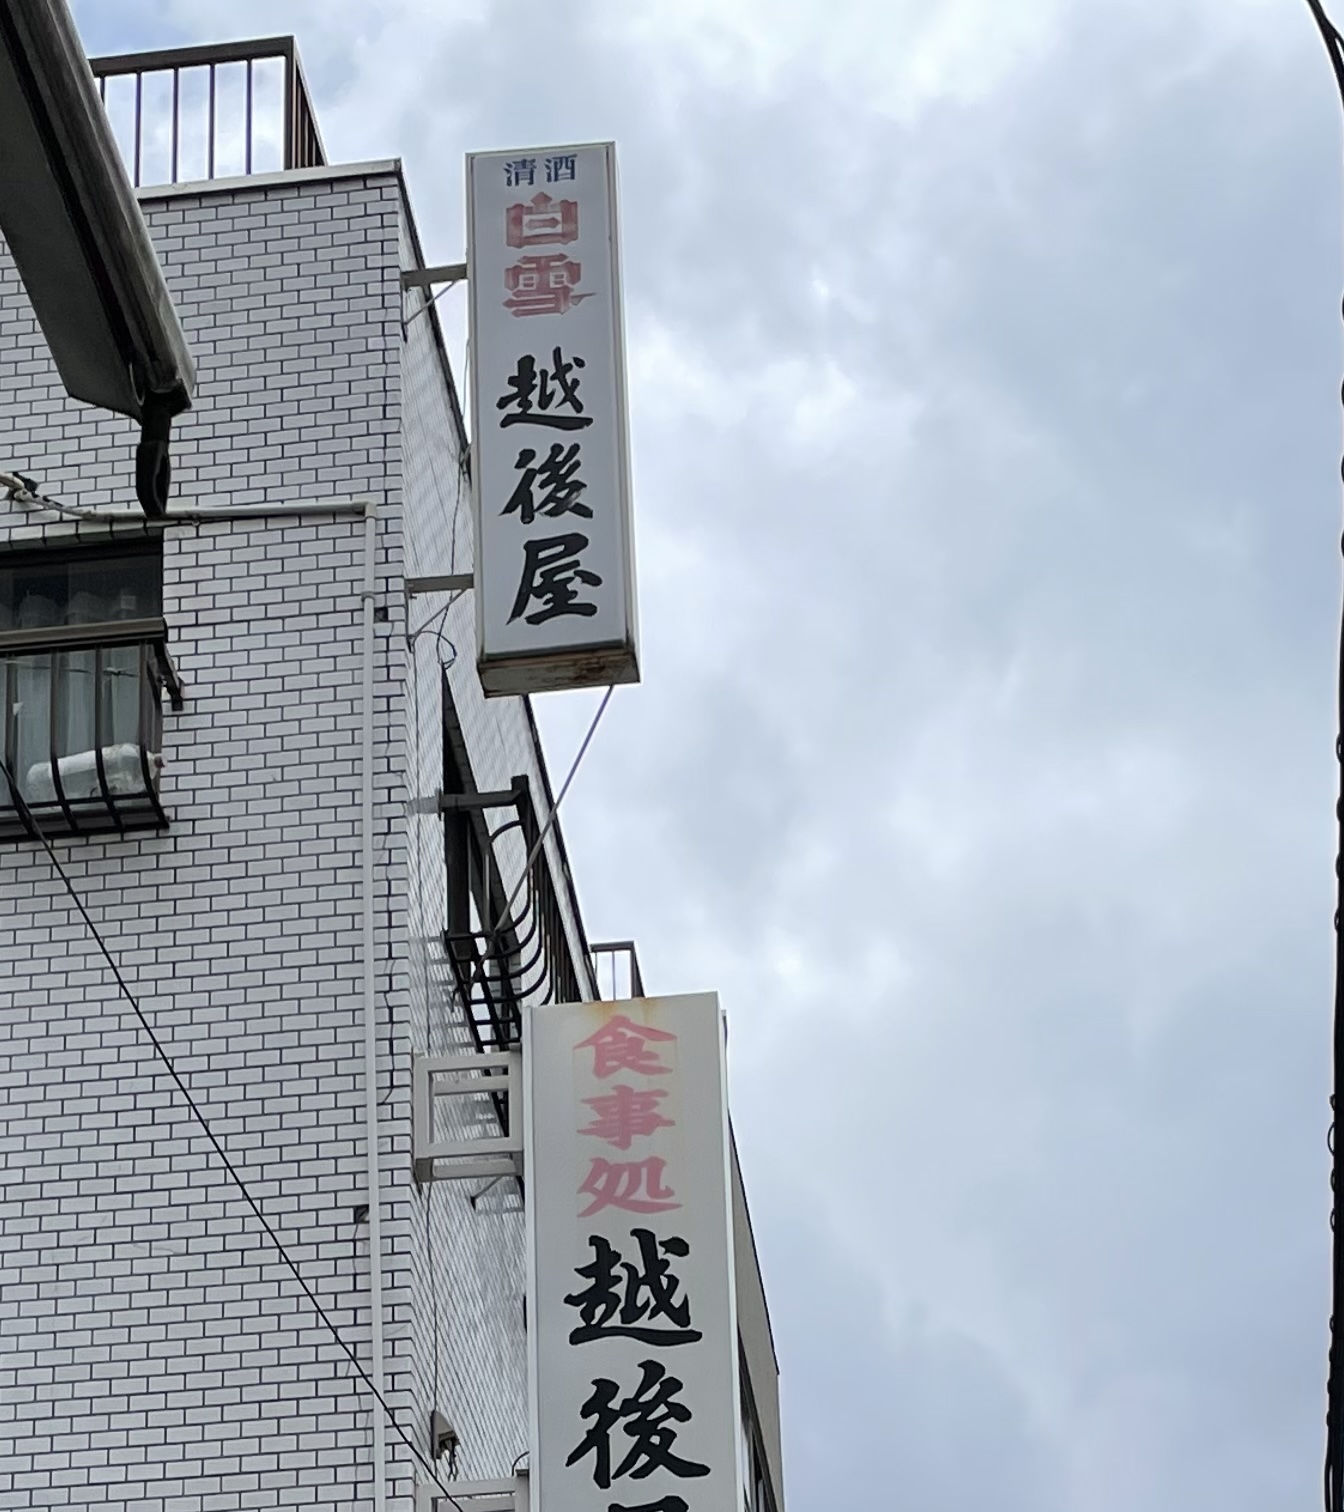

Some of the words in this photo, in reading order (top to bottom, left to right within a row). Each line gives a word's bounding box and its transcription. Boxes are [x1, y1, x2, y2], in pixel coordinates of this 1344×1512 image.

[503, 153, 579, 187] 清酒
[502, 191, 598, 317] 白雪
[496, 346, 603, 626] 越後屋
[573, 1015, 683, 1217] 食事処
